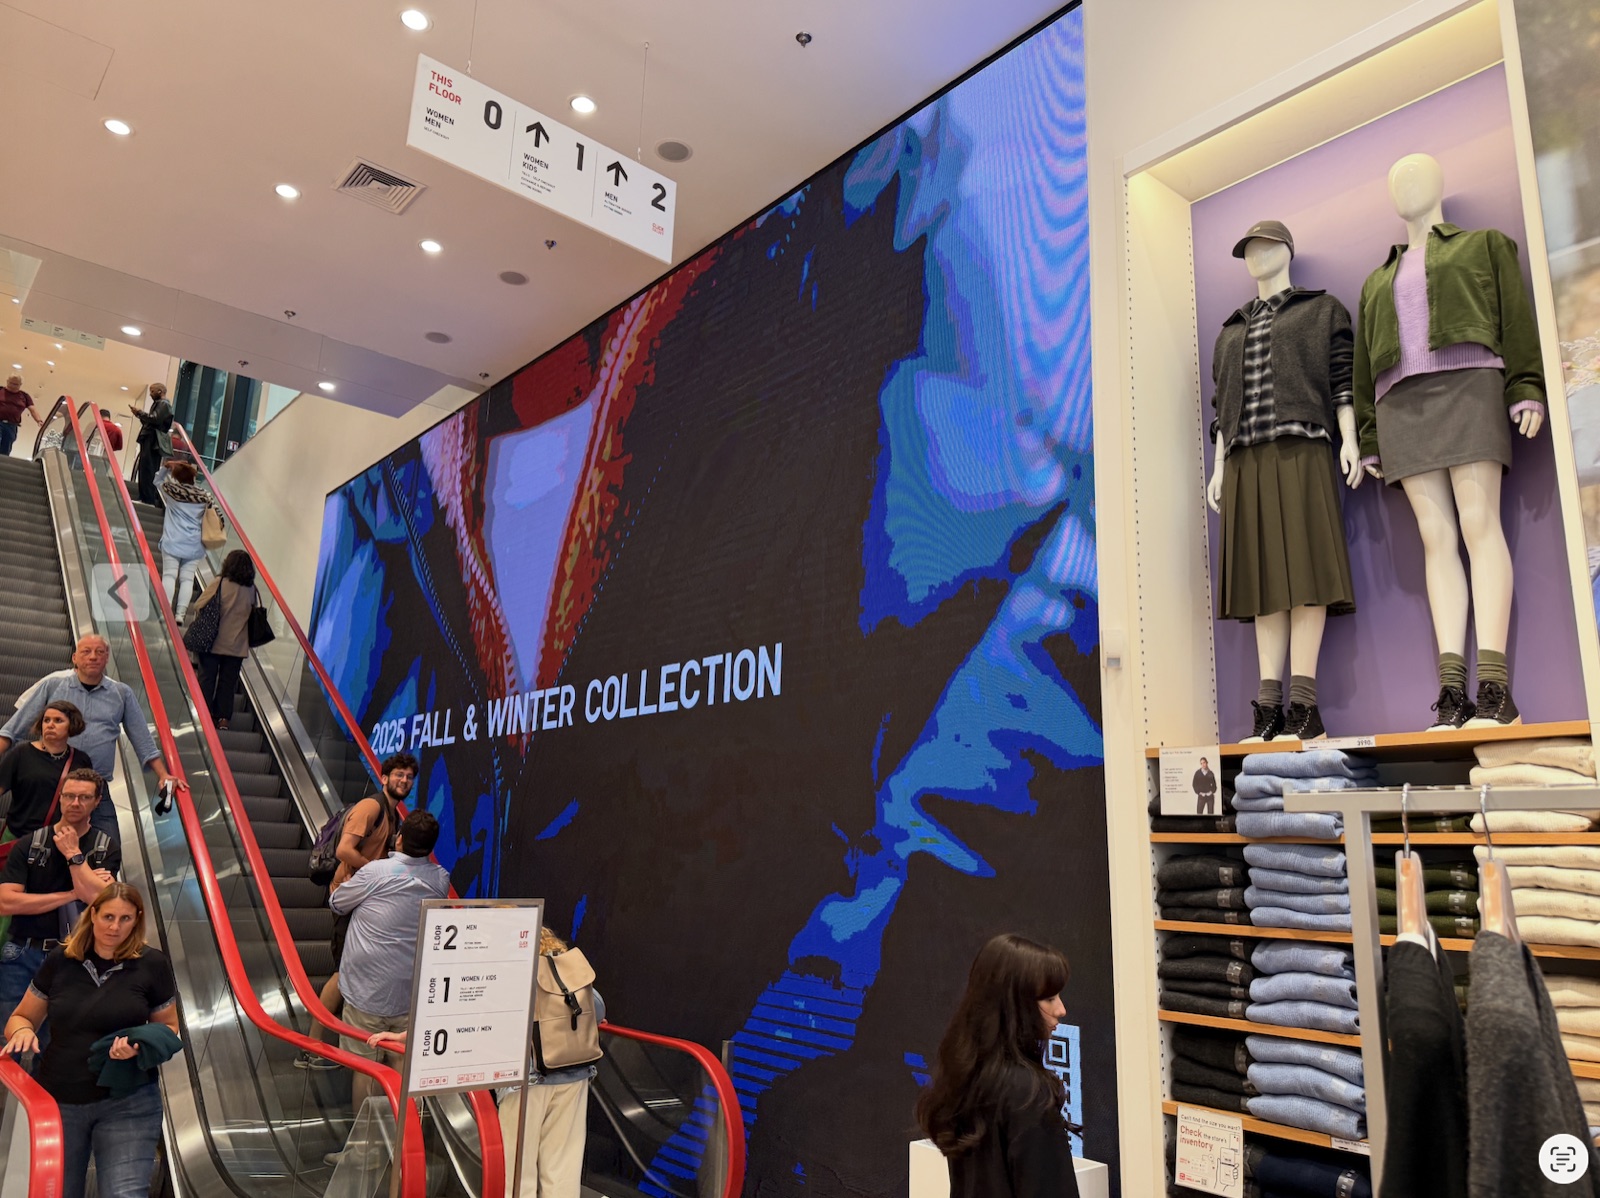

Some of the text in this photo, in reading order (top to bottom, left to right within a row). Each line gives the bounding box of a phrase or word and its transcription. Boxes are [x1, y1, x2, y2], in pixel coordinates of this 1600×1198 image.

[431, 70, 453, 88] THIS
[428, 82, 462, 105] FLOOR
[424, 116, 442, 129] MEN
[426, 107, 455, 125] WOMEN
[483, 100, 503, 130] 0
[522, 161, 538, 173] KIDS
[523, 152, 549, 170] WOMEN
[575, 142, 585, 171] 1
[604, 191, 618, 203] MEN
[651, 182, 667, 212] 2
[371, 642, 783, 756] 2025 FALL & WINTER COLLECTION
[432, 924, 442, 951] FLOOR
[443, 924, 458, 950] 2
[519, 930, 529, 939] UT
[428, 977, 437, 1004] FLOOR
[443, 976, 451, 1003] 1
[456, 1026, 475, 1034] WOMEN
[422, 1029, 432, 1057] FLOOR
[433, 1028, 448, 1056] 0
[1180, 1124, 1203, 1138] Check
[1179, 1135, 1214, 1152] inventory
